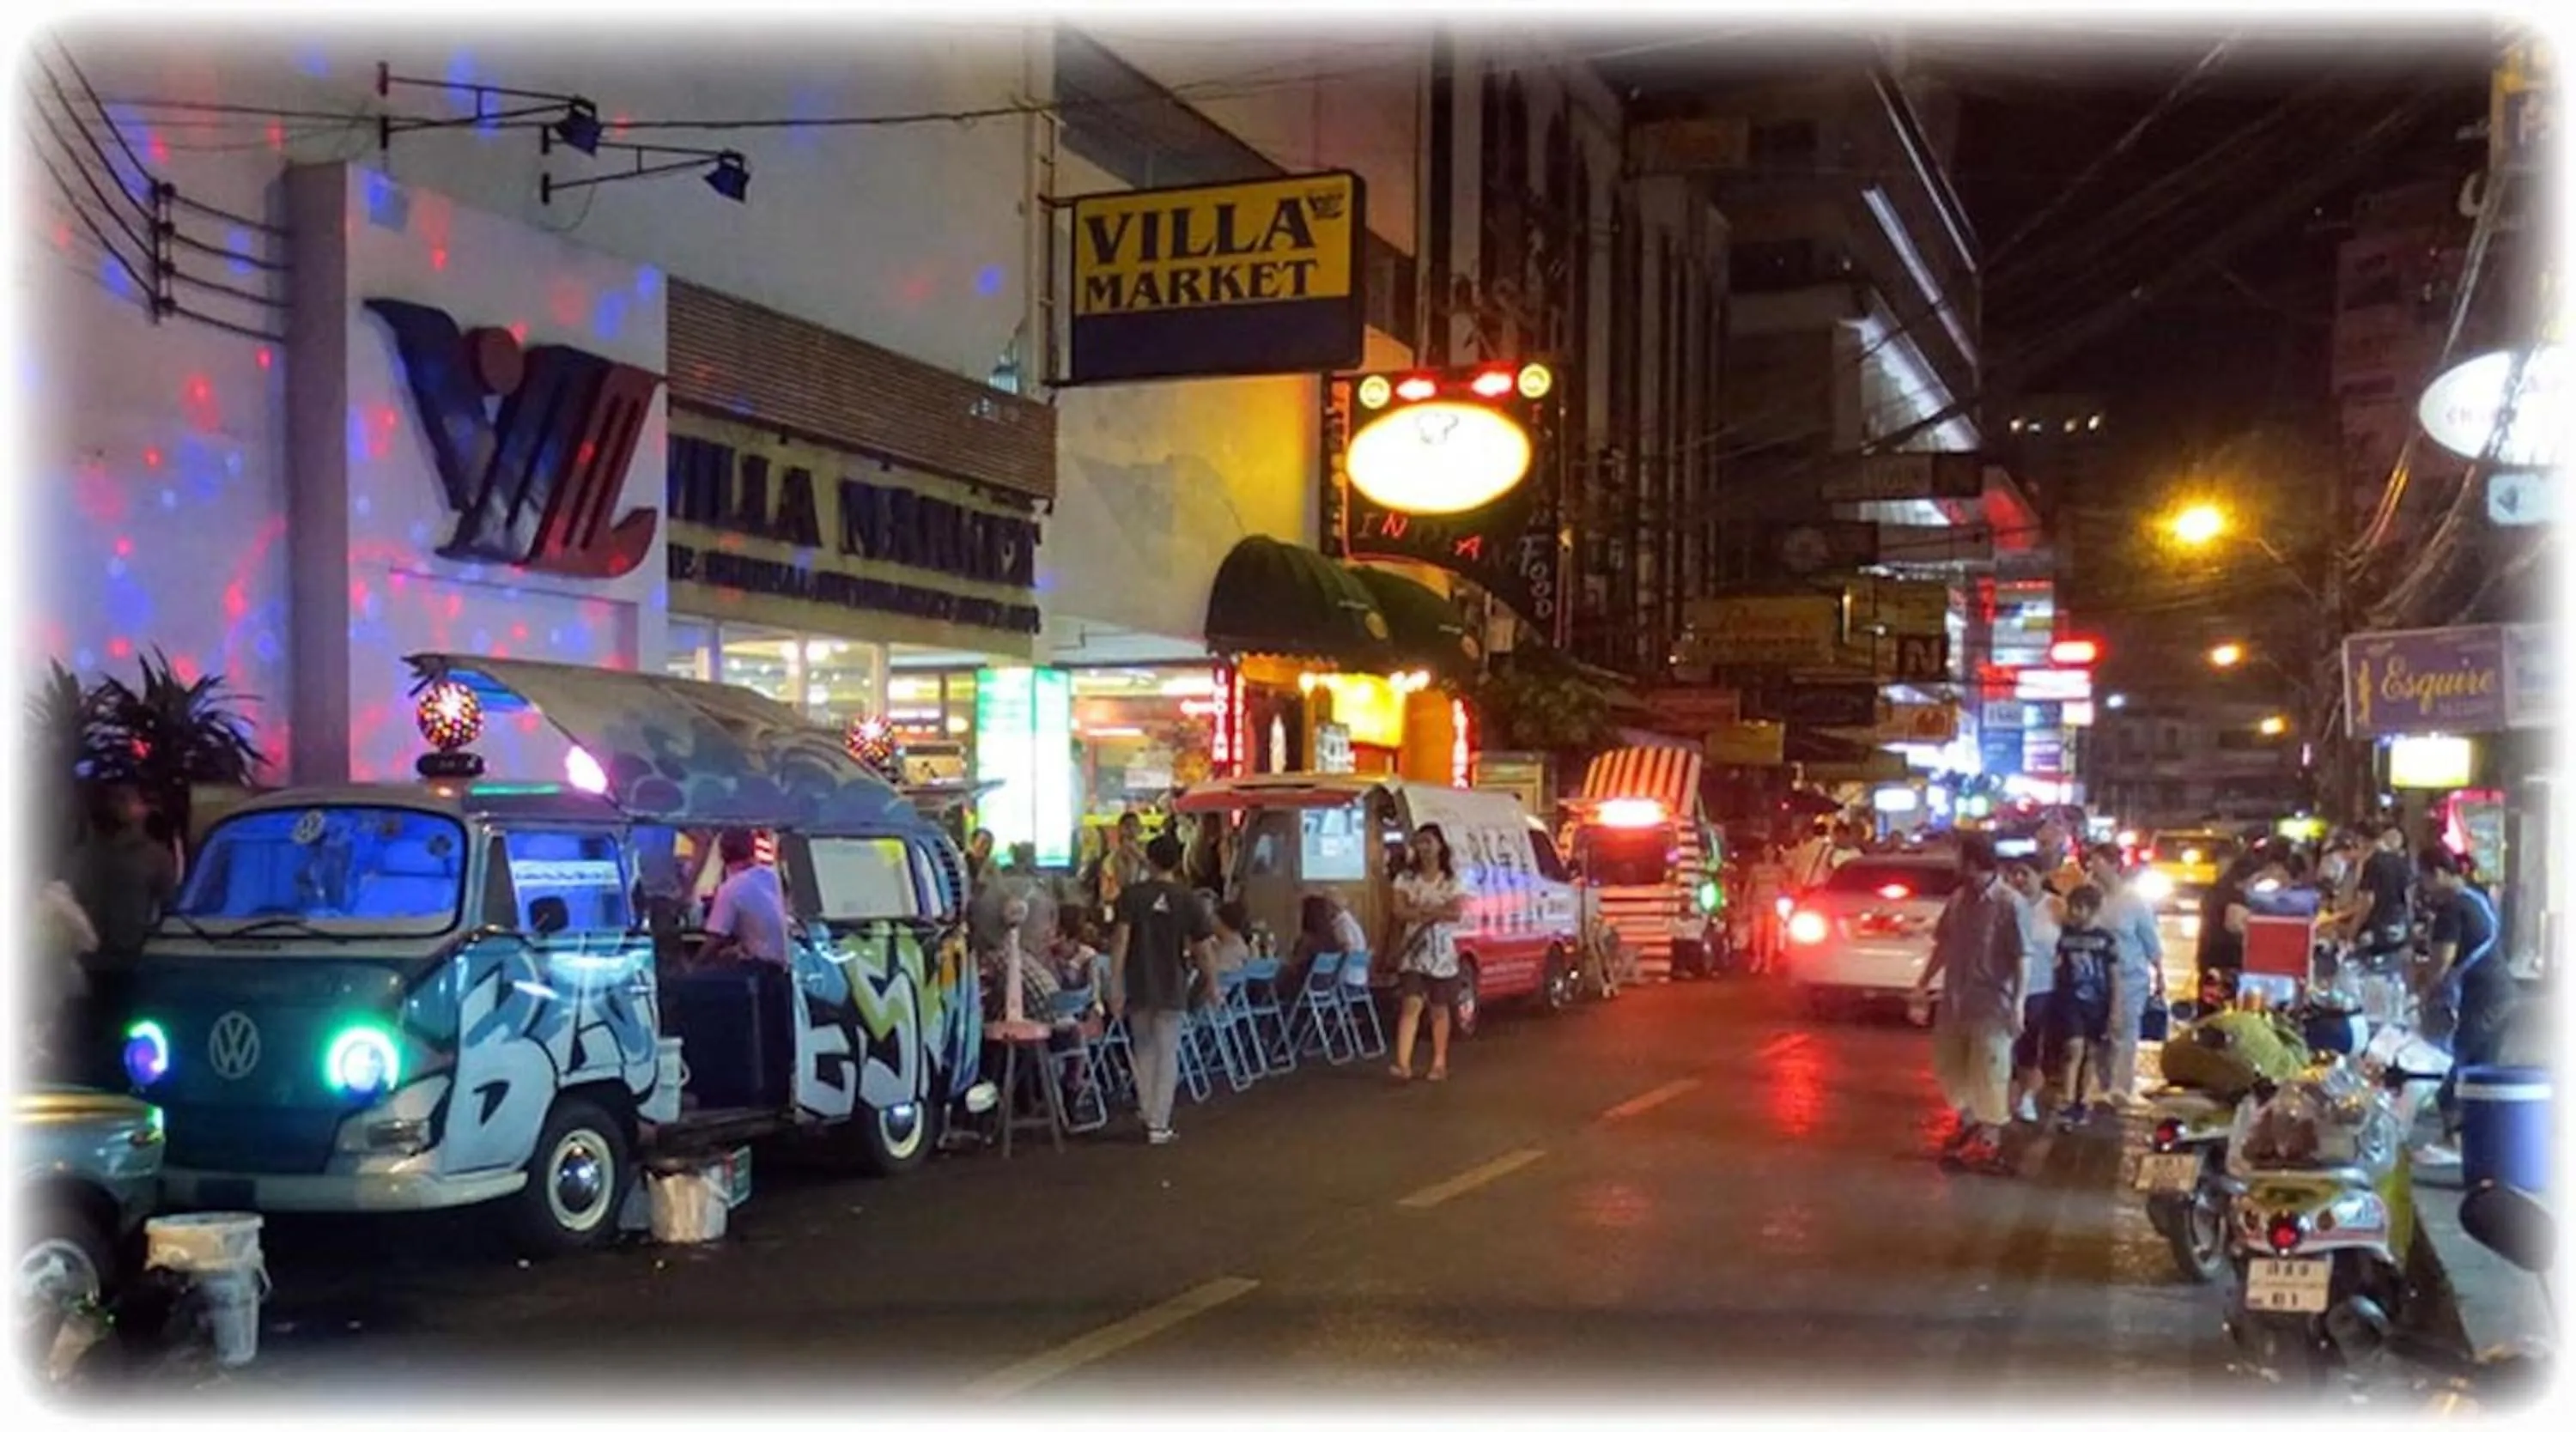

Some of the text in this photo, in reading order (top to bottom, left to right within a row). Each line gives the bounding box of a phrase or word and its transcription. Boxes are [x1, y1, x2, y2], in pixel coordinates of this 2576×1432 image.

[1084, 197, 1316, 266] VILLA
[1084, 259, 1318, 312] MARKET
[2381, 655, 2496, 715] Esquire
